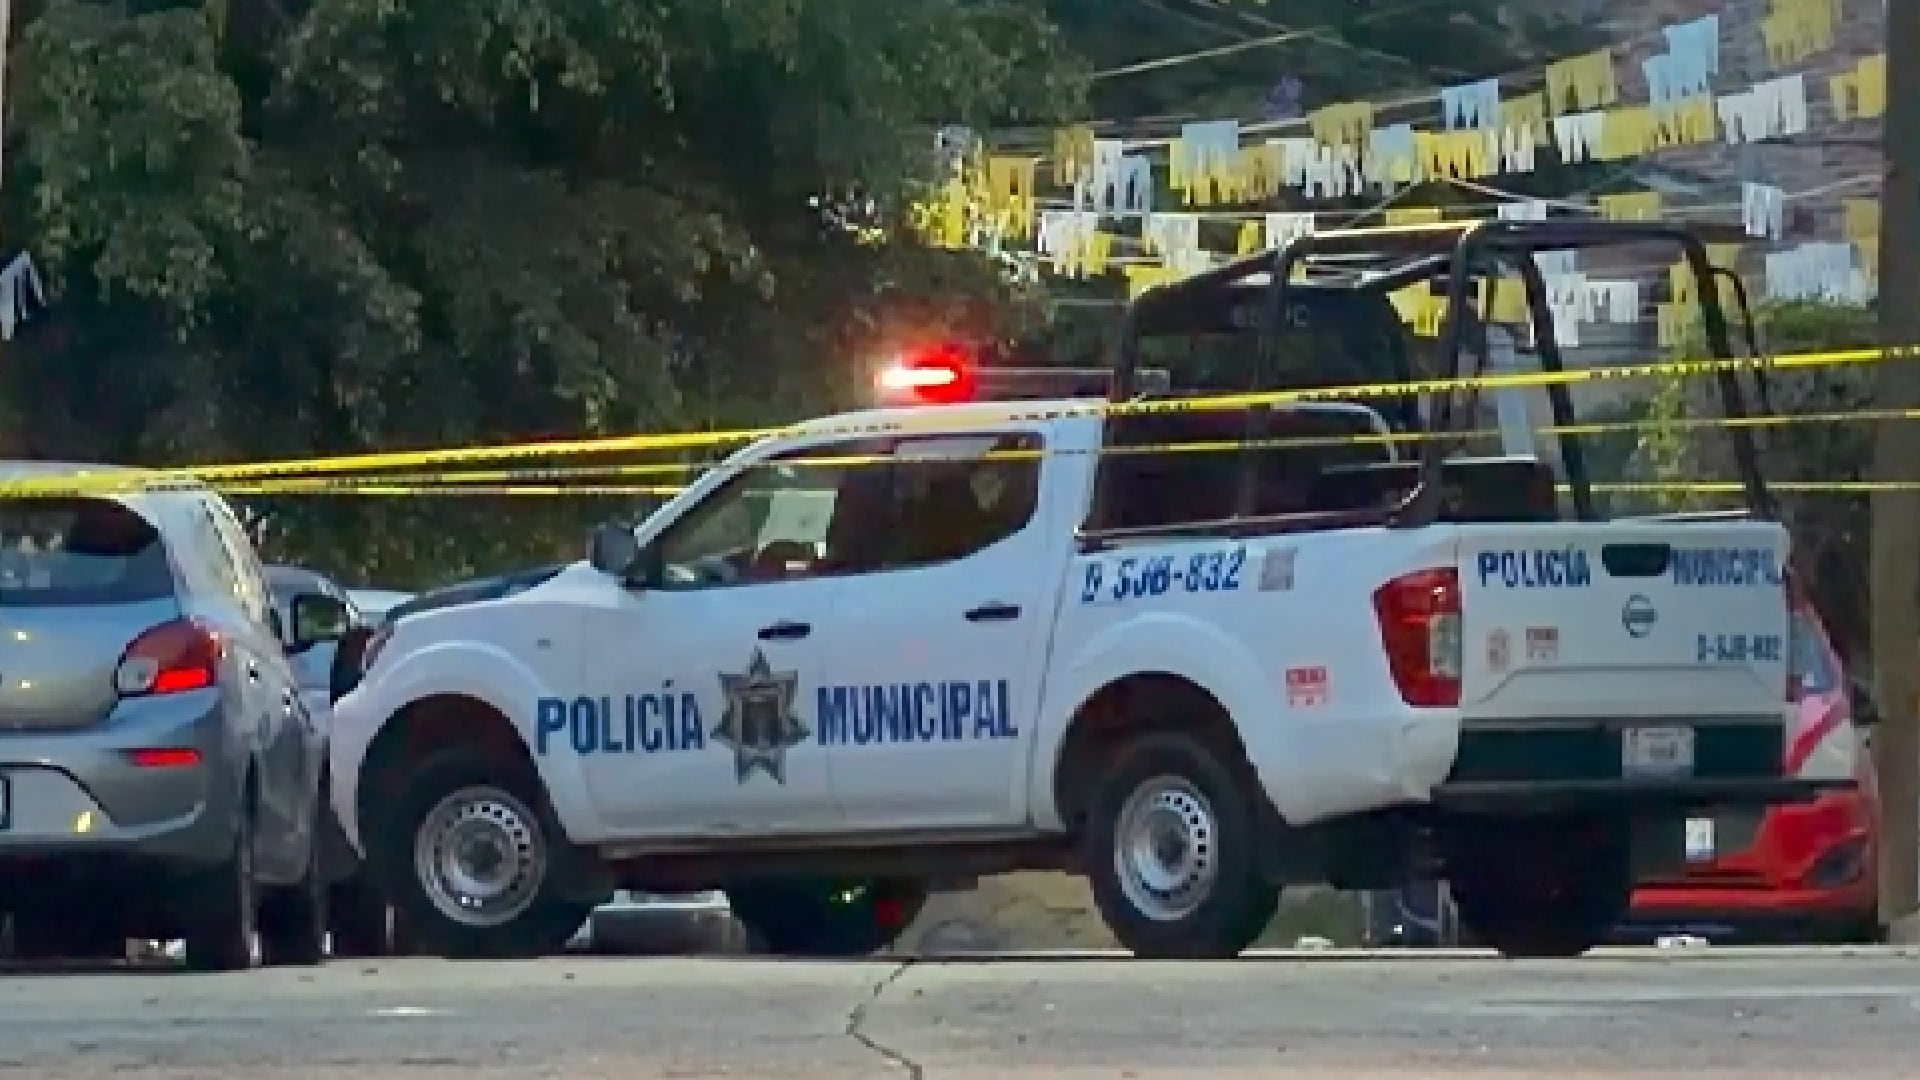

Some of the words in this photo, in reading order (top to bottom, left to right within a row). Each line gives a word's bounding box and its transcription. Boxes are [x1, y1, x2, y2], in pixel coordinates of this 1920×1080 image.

[1477, 543, 1591, 588] POLICÍA
[536, 680, 706, 756] POLICÍA
[817, 679, 1019, 746] MUNICIPAL
